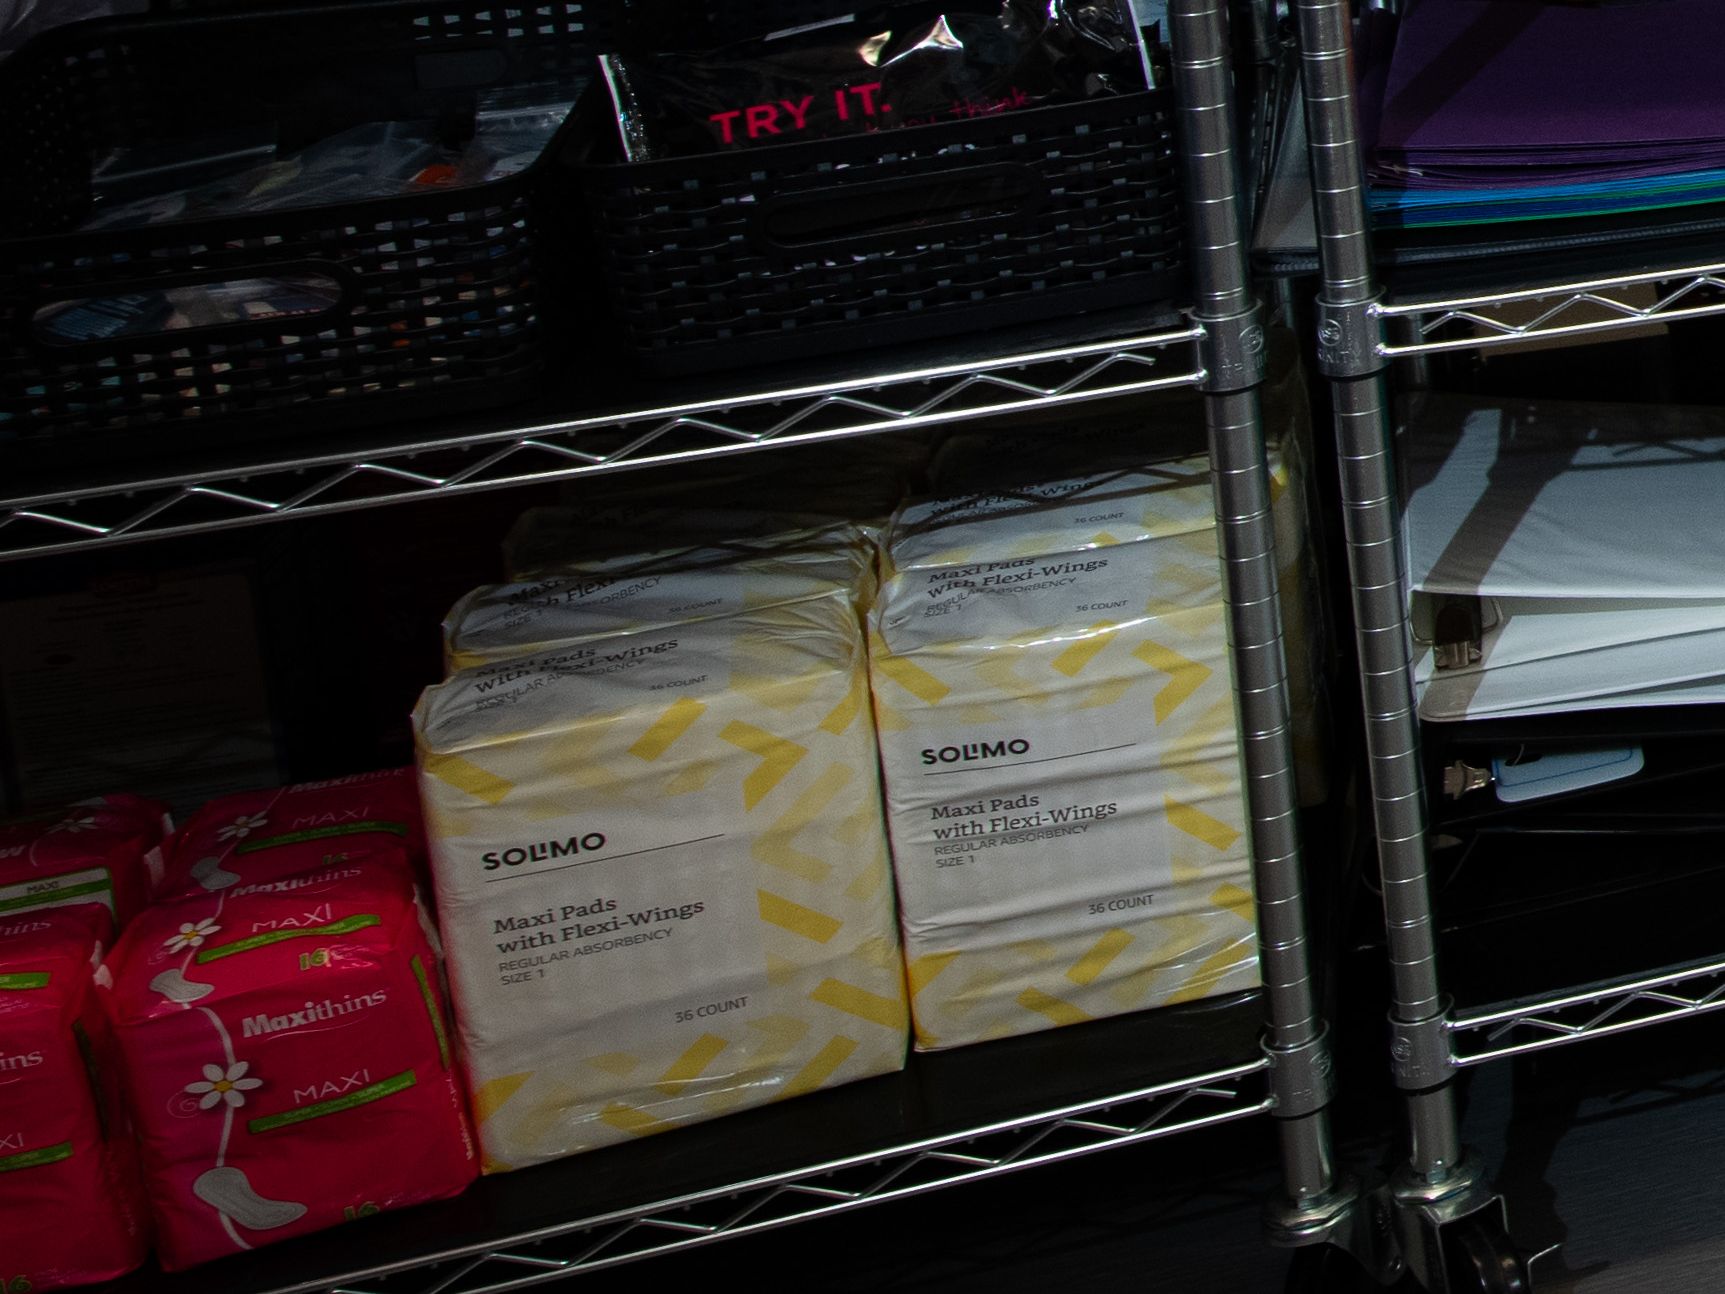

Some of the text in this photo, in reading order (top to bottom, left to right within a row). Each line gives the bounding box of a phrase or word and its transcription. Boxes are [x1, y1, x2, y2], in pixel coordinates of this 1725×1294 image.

[708, 82, 893, 144] TRY IT.
[927, 556, 1037, 584] Maxi Pads
[981, 555, 1109, 589] Flexi-Wings
[1096, 598, 1129, 612] COUNT
[920, 738, 1031, 766] SOLIMO
[290, 805, 370, 829] MAXI
[930, 793, 1040, 822] Maxi Pads
[932, 798, 1119, 840] with Flexi-Wings
[481, 832, 607, 872] SOLIMO
[934, 824, 1090, 856] REGULAR ABSORBENCY
[26, 879, 59, 894] MAXI
[250, 903, 333, 934] MAXI
[493, 897, 618, 935] Maxi Pads
[1088, 893, 1155, 916] 36 COUNT
[496, 900, 706, 955] with Flexi-Wings
[498, 927, 674, 973] REGULAR ABSORBENCY
[500, 970, 534, 986] SIZE
[241, 987, 388, 1039] Maxithins
[674, 995, 749, 1024] 36 COUNT
[291, 1068, 371, 1104] MAXI
